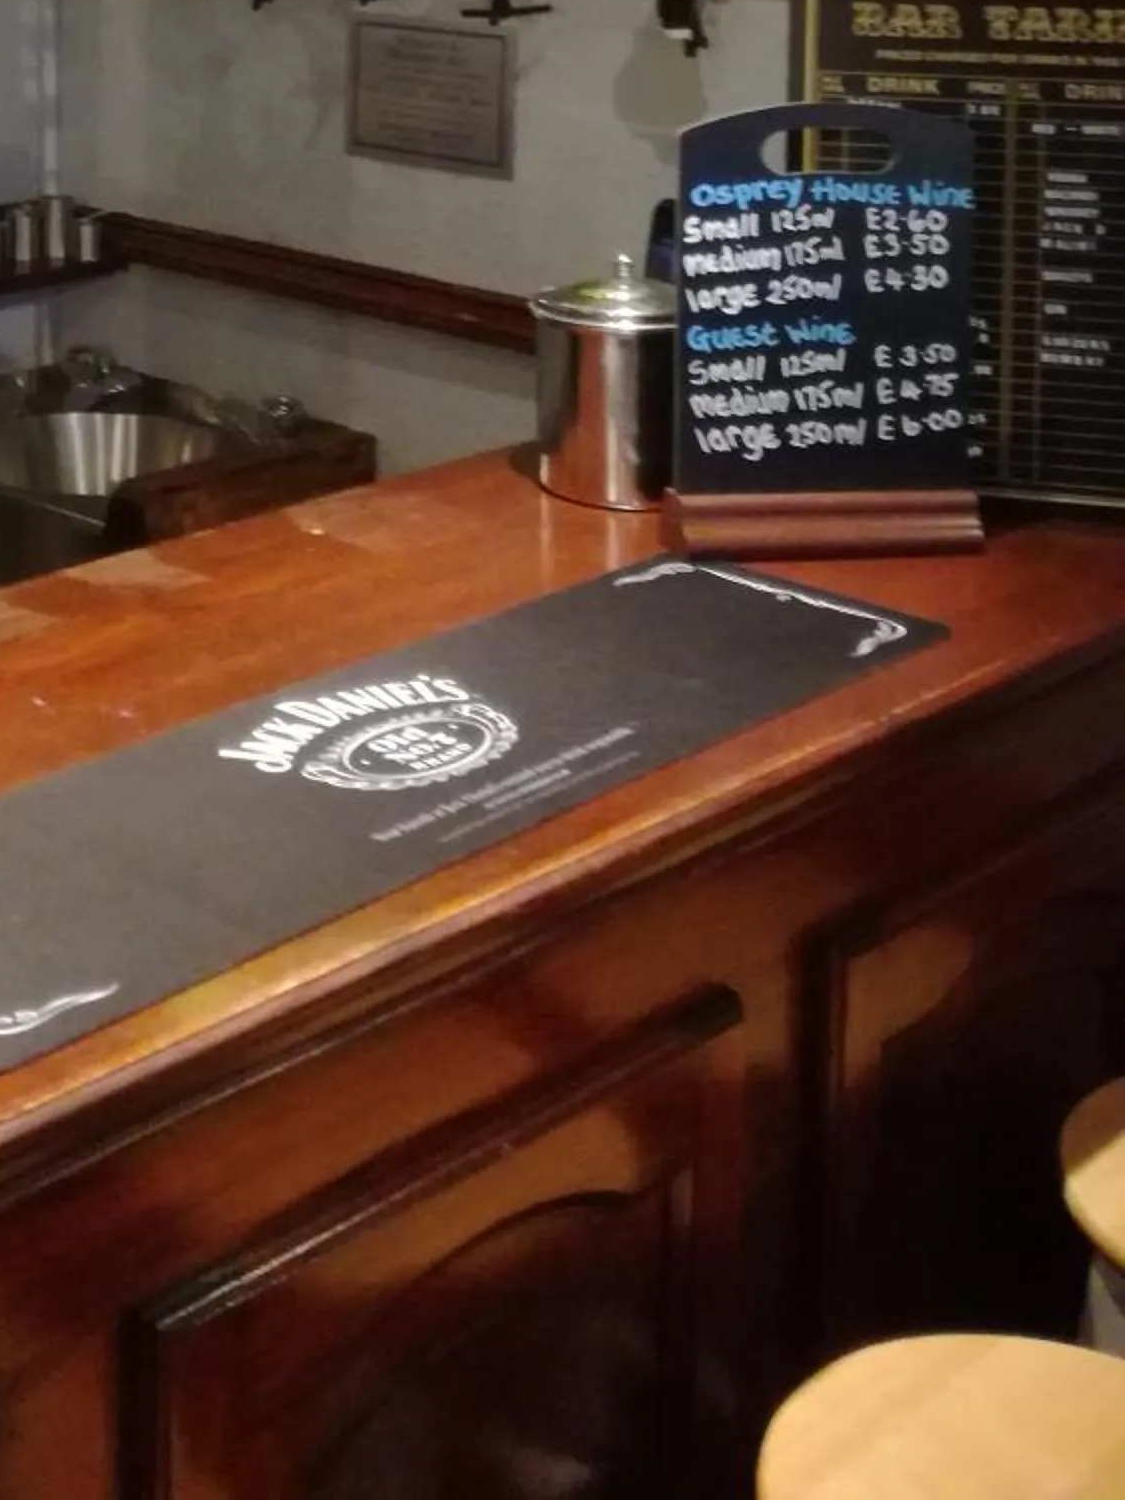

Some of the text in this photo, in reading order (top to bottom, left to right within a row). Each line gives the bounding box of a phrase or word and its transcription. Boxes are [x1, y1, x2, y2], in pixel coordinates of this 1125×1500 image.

[851, 1, 963, 39] BAR
[866, 77, 940, 95] DRINK
[1064, 82, 1125, 100] DRIN
